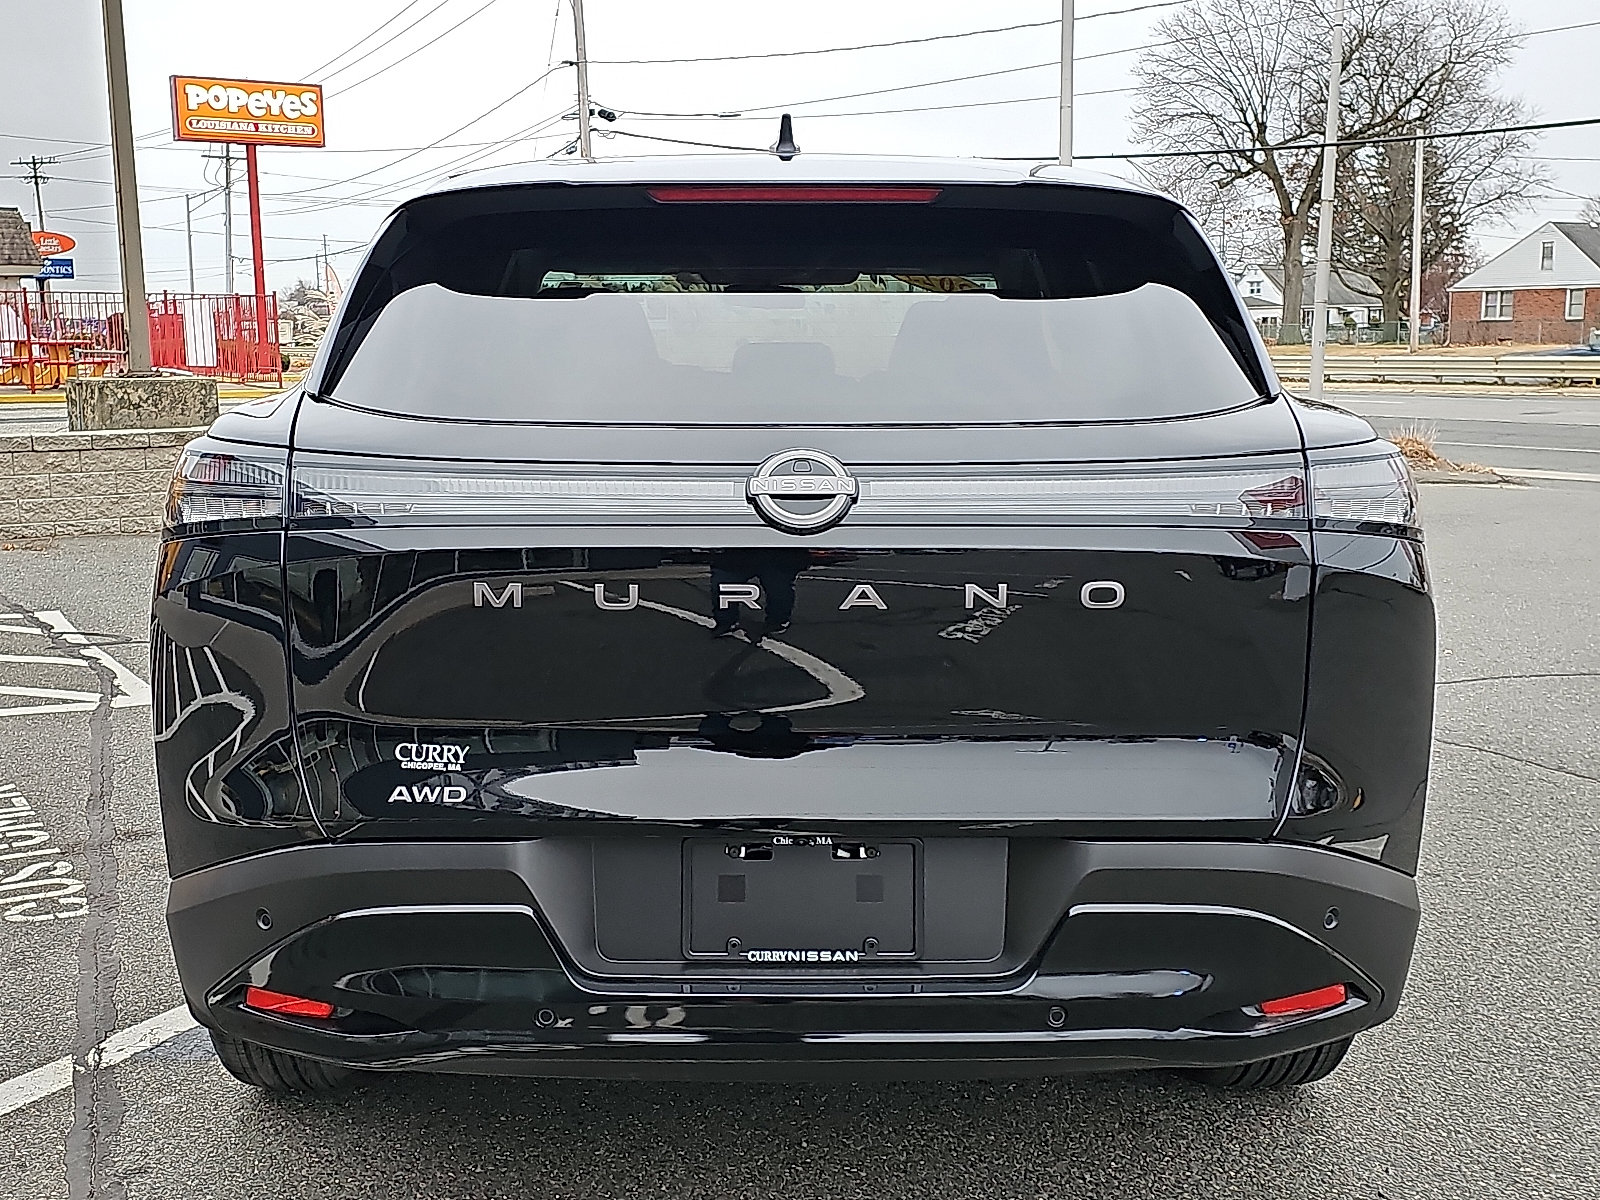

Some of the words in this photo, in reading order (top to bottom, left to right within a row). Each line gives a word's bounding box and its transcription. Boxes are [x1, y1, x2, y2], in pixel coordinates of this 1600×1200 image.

[190, 119, 256, 132] LOUISIANA
[257, 123, 313, 135] KITCHEN
[753, 479, 853, 492] NISSAN
[473, 580, 1126, 611] MURANO
[395, 743, 470, 763] CURRY
[447, 763, 462, 771] MA
[387, 785, 467, 803] AWD
[815, 836, 833, 845] MA
